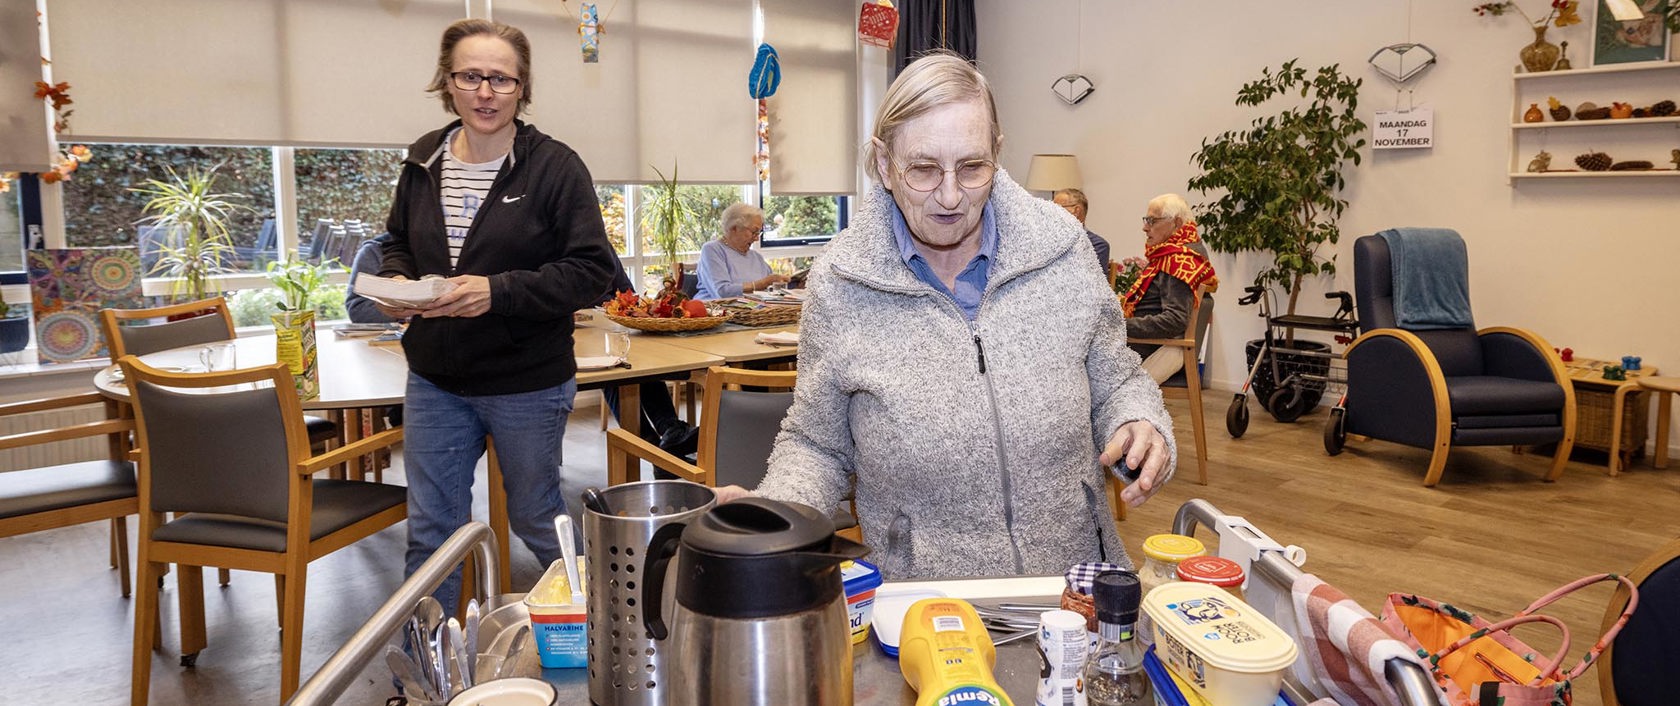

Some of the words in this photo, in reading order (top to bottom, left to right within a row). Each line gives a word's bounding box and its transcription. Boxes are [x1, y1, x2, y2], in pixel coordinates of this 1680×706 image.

[1379, 120, 1427, 128] MAANDAG
[1397, 129, 1409, 137] 17
[1374, 138, 1430, 146] NOVEMBER
[938, 690, 1001, 706] Remia
